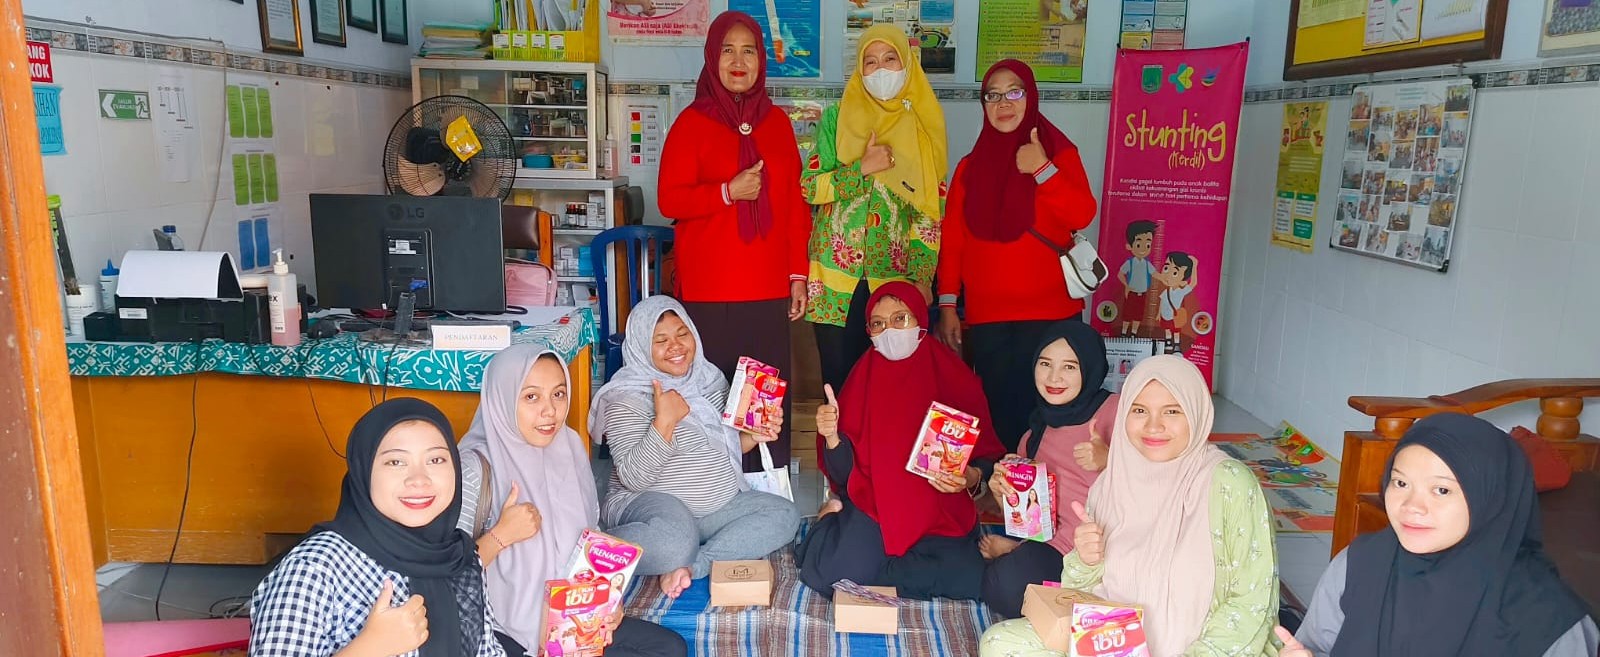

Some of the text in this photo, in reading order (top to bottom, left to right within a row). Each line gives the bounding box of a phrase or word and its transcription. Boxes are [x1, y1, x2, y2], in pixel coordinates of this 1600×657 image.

[1124, 109, 1227, 162] Stunting
[1168, 150, 1206, 170] (Kerdil)
[408, 207, 424, 218] LG
[941, 420, 967, 439] ibu
[589, 545, 630, 566] PRENAGEN
[565, 588, 595, 607] ibu
[1091, 632, 1126, 652] ibu
